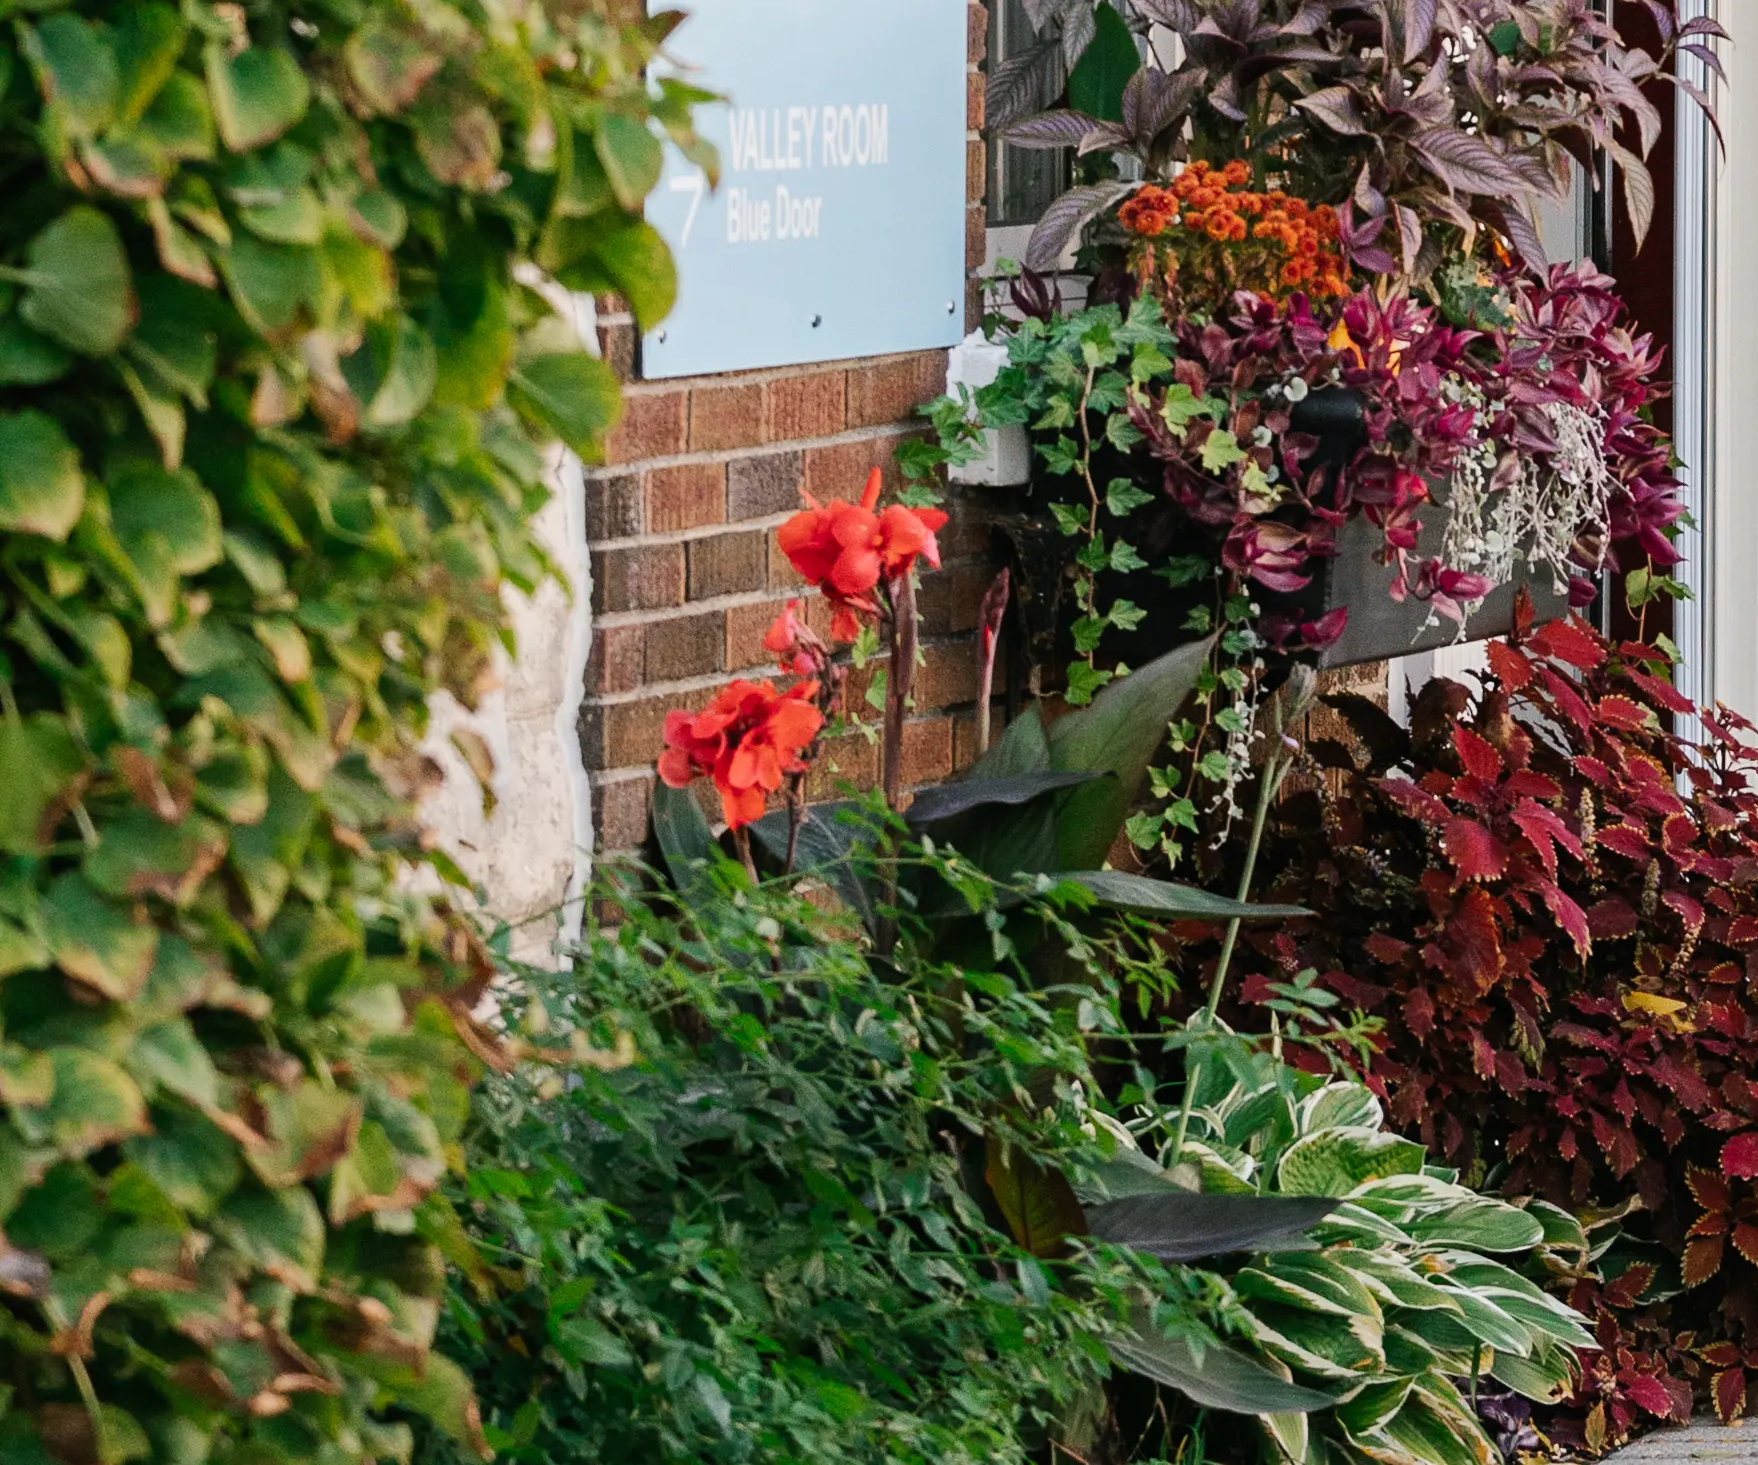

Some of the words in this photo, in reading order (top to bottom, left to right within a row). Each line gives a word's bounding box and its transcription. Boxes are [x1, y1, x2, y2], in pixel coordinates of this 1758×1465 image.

[729, 106, 815, 171] VALLEY
[822, 103, 888, 167] ROOM
[727, 187, 770, 243] Blue
[777, 184, 822, 239] Door
